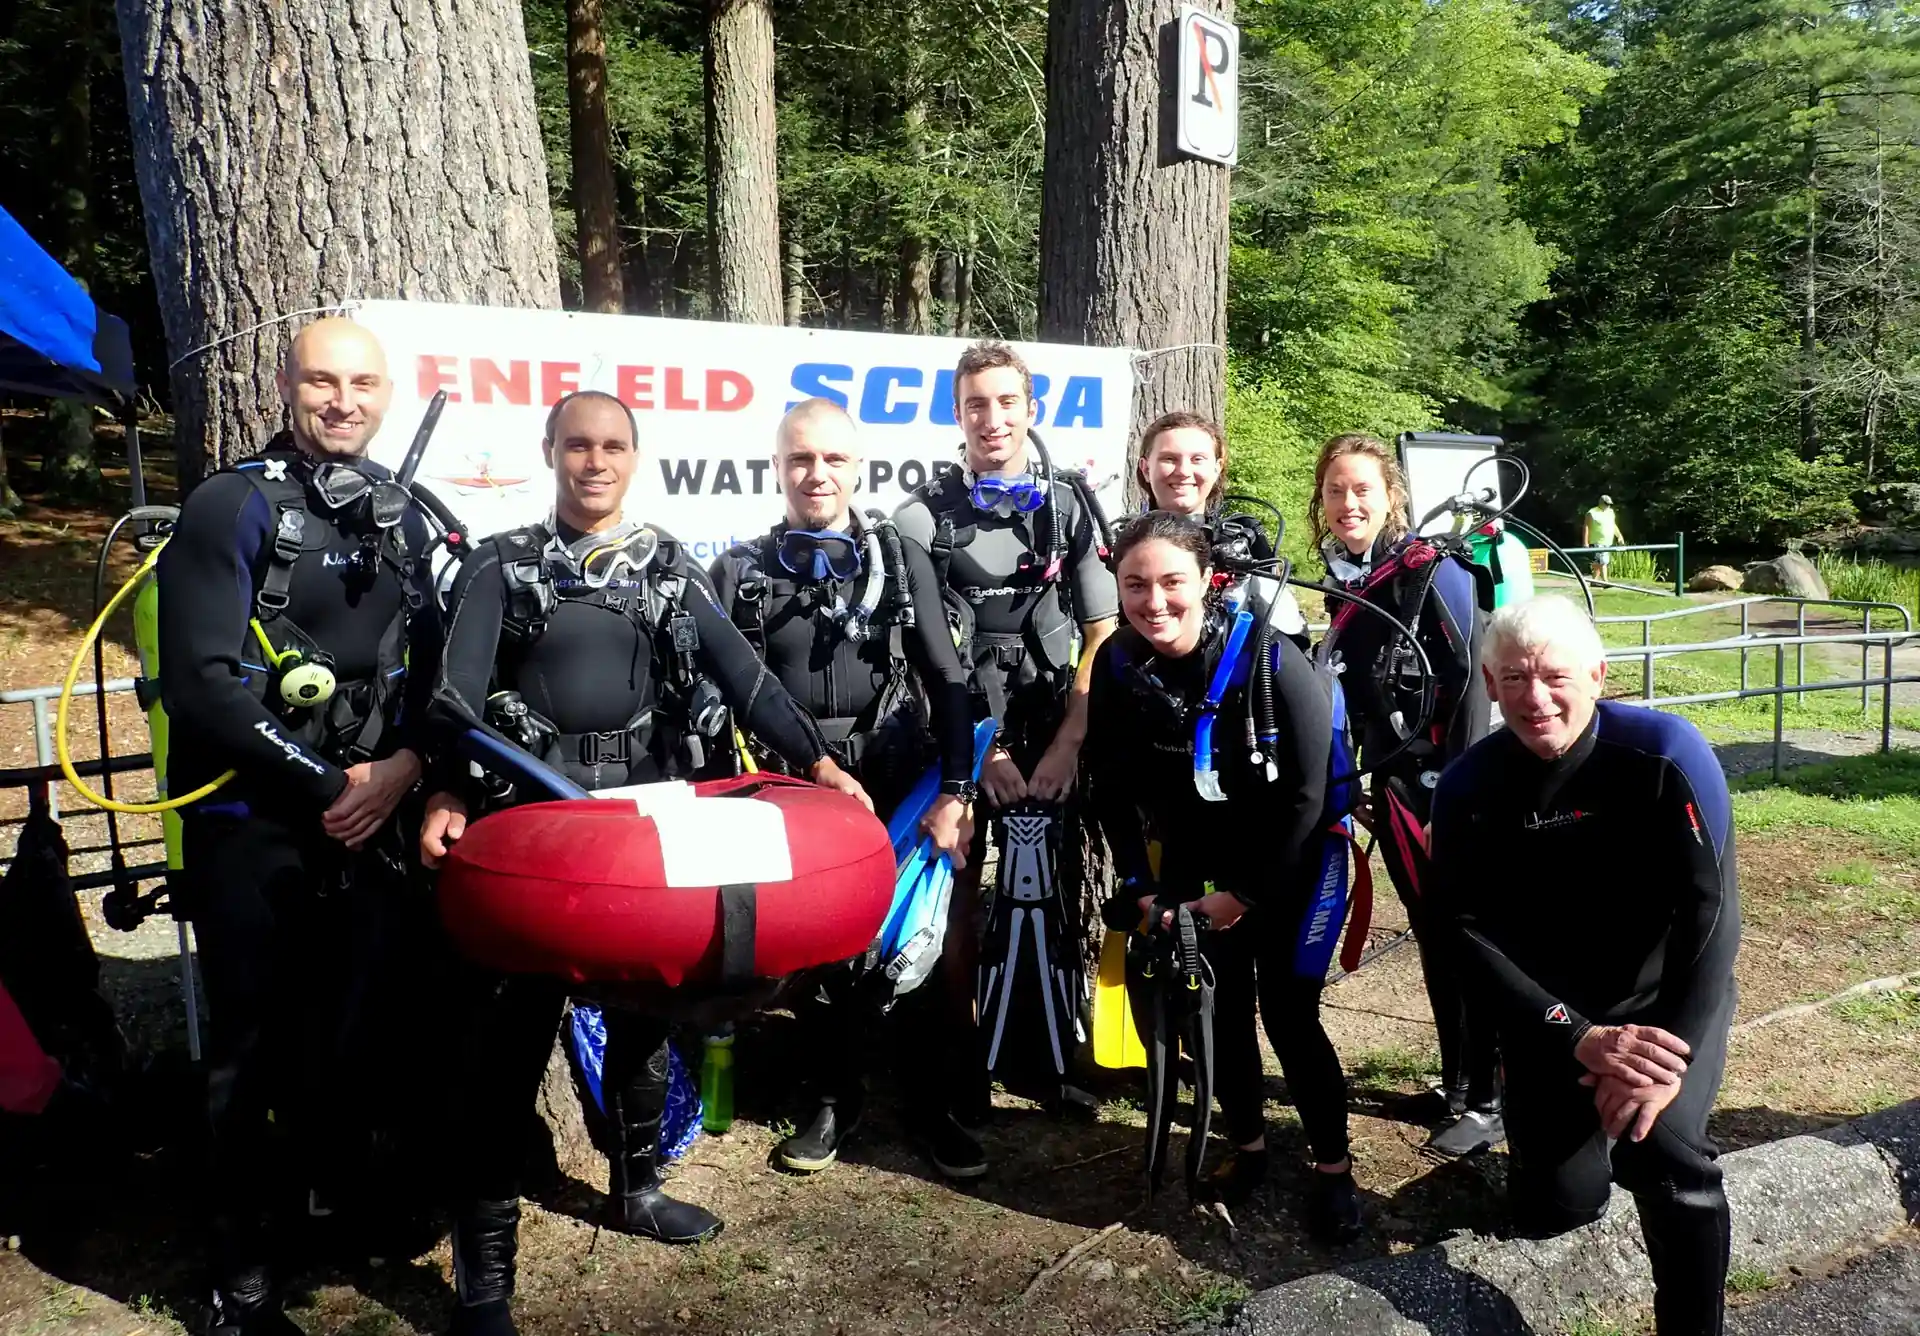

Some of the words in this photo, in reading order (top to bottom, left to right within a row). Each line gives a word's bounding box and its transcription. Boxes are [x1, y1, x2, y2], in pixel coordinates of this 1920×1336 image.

[416, 354, 754, 412] ENFELD
[253, 720, 326, 775] NeoSport
[1319, 851, 1343, 901] SCUBA
[1304, 909, 1332, 946] MAX
